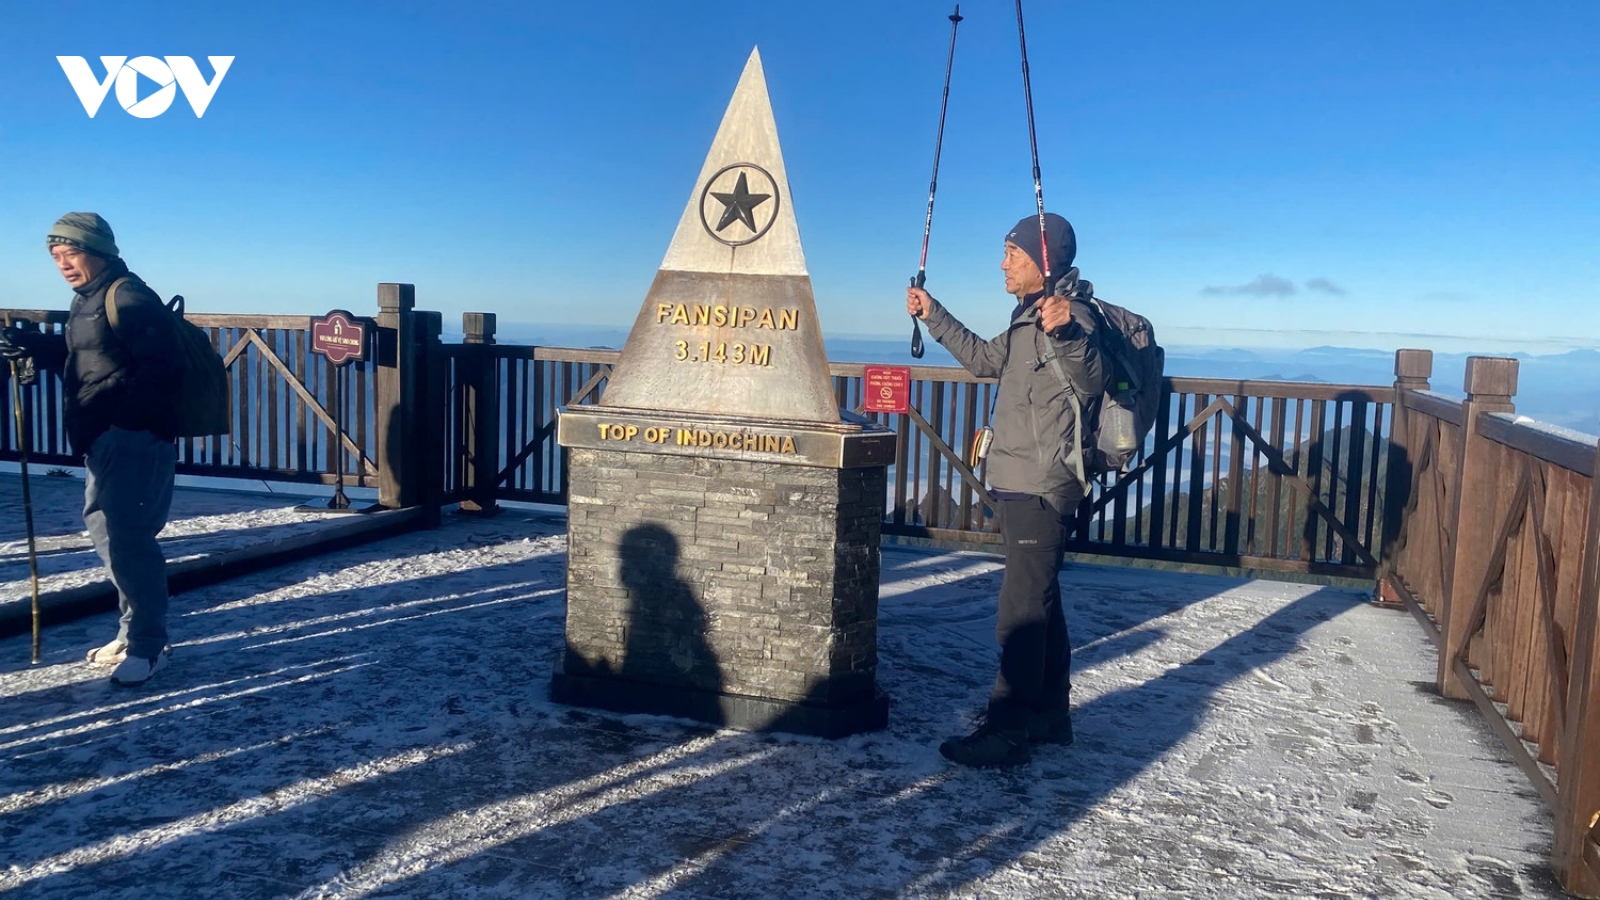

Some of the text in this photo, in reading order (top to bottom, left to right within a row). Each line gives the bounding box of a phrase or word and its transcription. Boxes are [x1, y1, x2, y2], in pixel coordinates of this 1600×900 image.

[656, 302, 799, 330] FANSIPAN
[675, 340, 771, 366] 3.143M
[597, 423, 797, 454] TOP OF INDOCHINA
